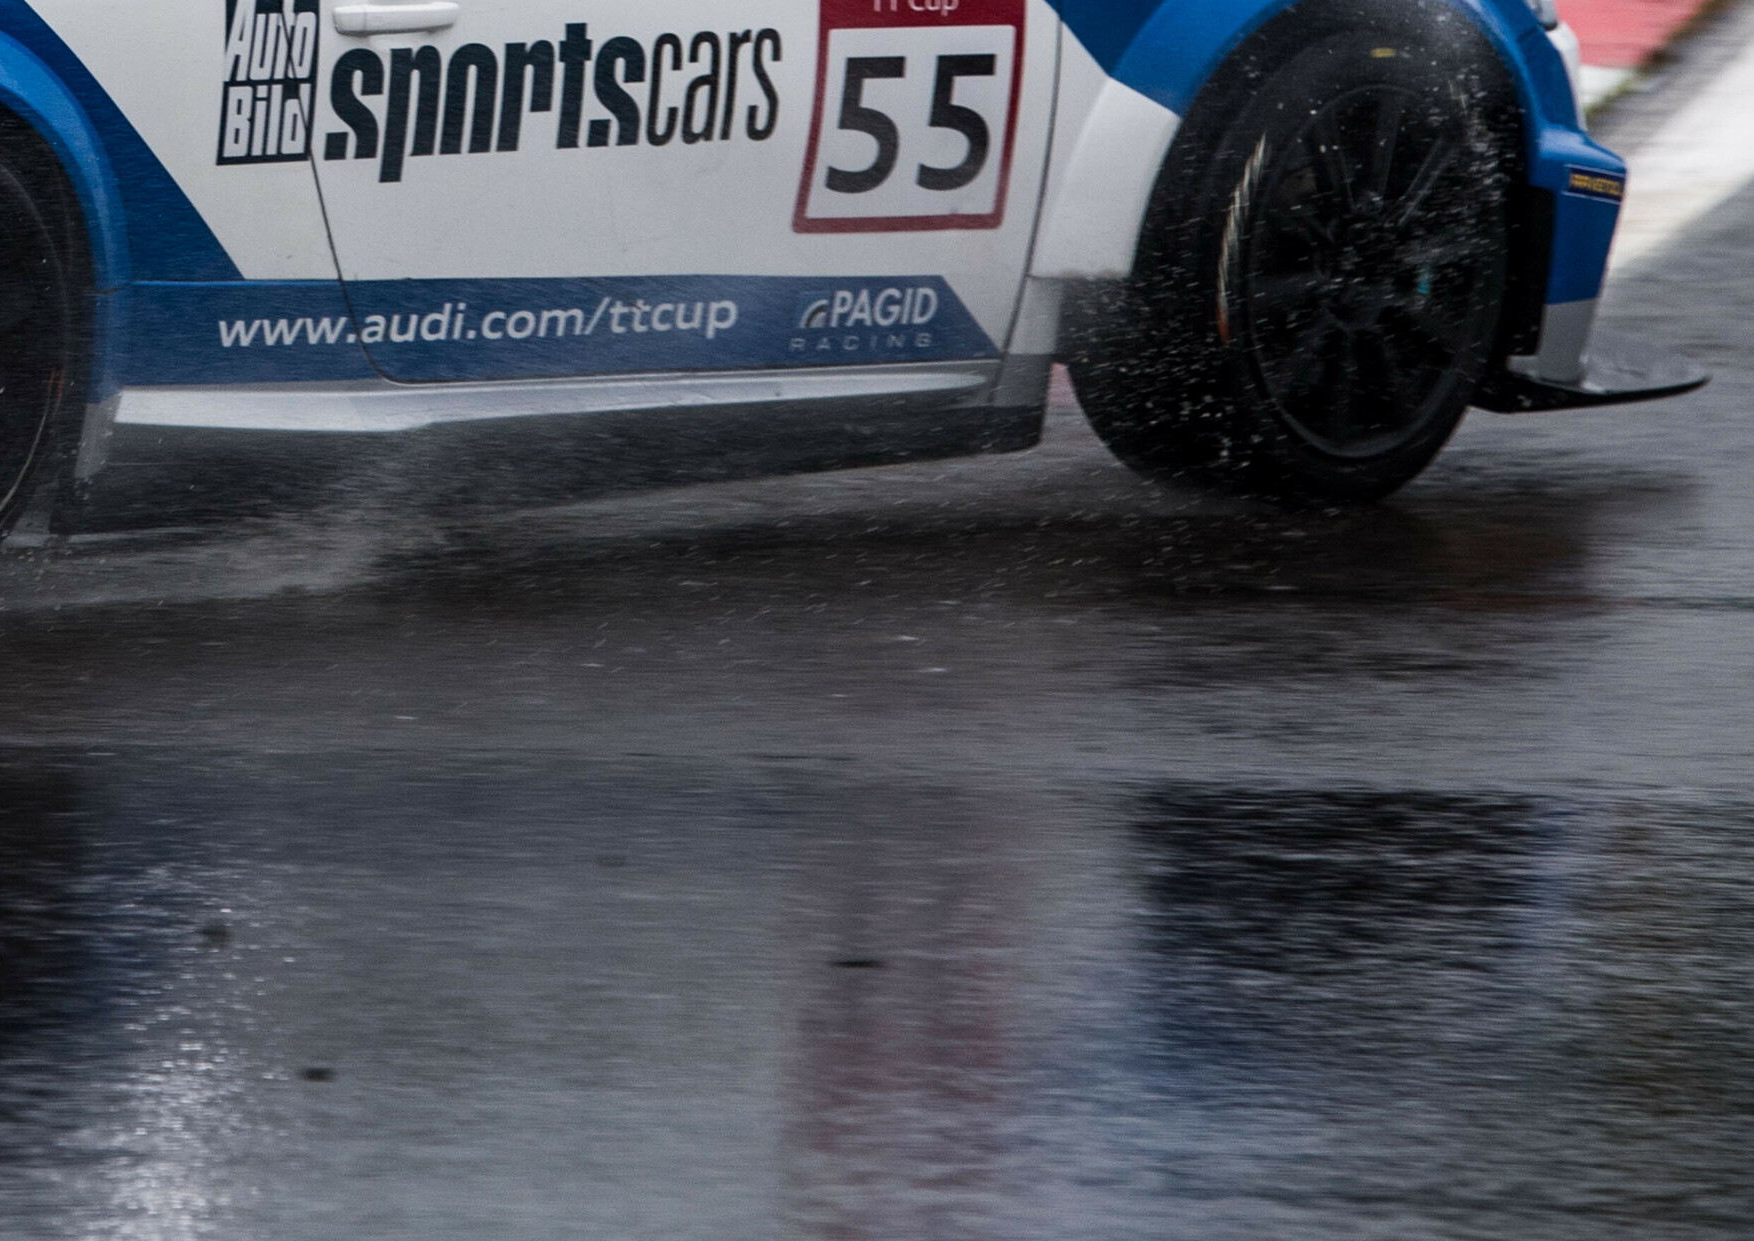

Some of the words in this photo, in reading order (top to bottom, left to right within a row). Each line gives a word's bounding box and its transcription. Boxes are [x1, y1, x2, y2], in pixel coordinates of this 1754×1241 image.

[222, 82, 313, 158] Bild
[825, 53, 997, 194] 55
[217, 296, 738, 348] www.audi.com/ttcup
[829, 287, 939, 328] PAGID
